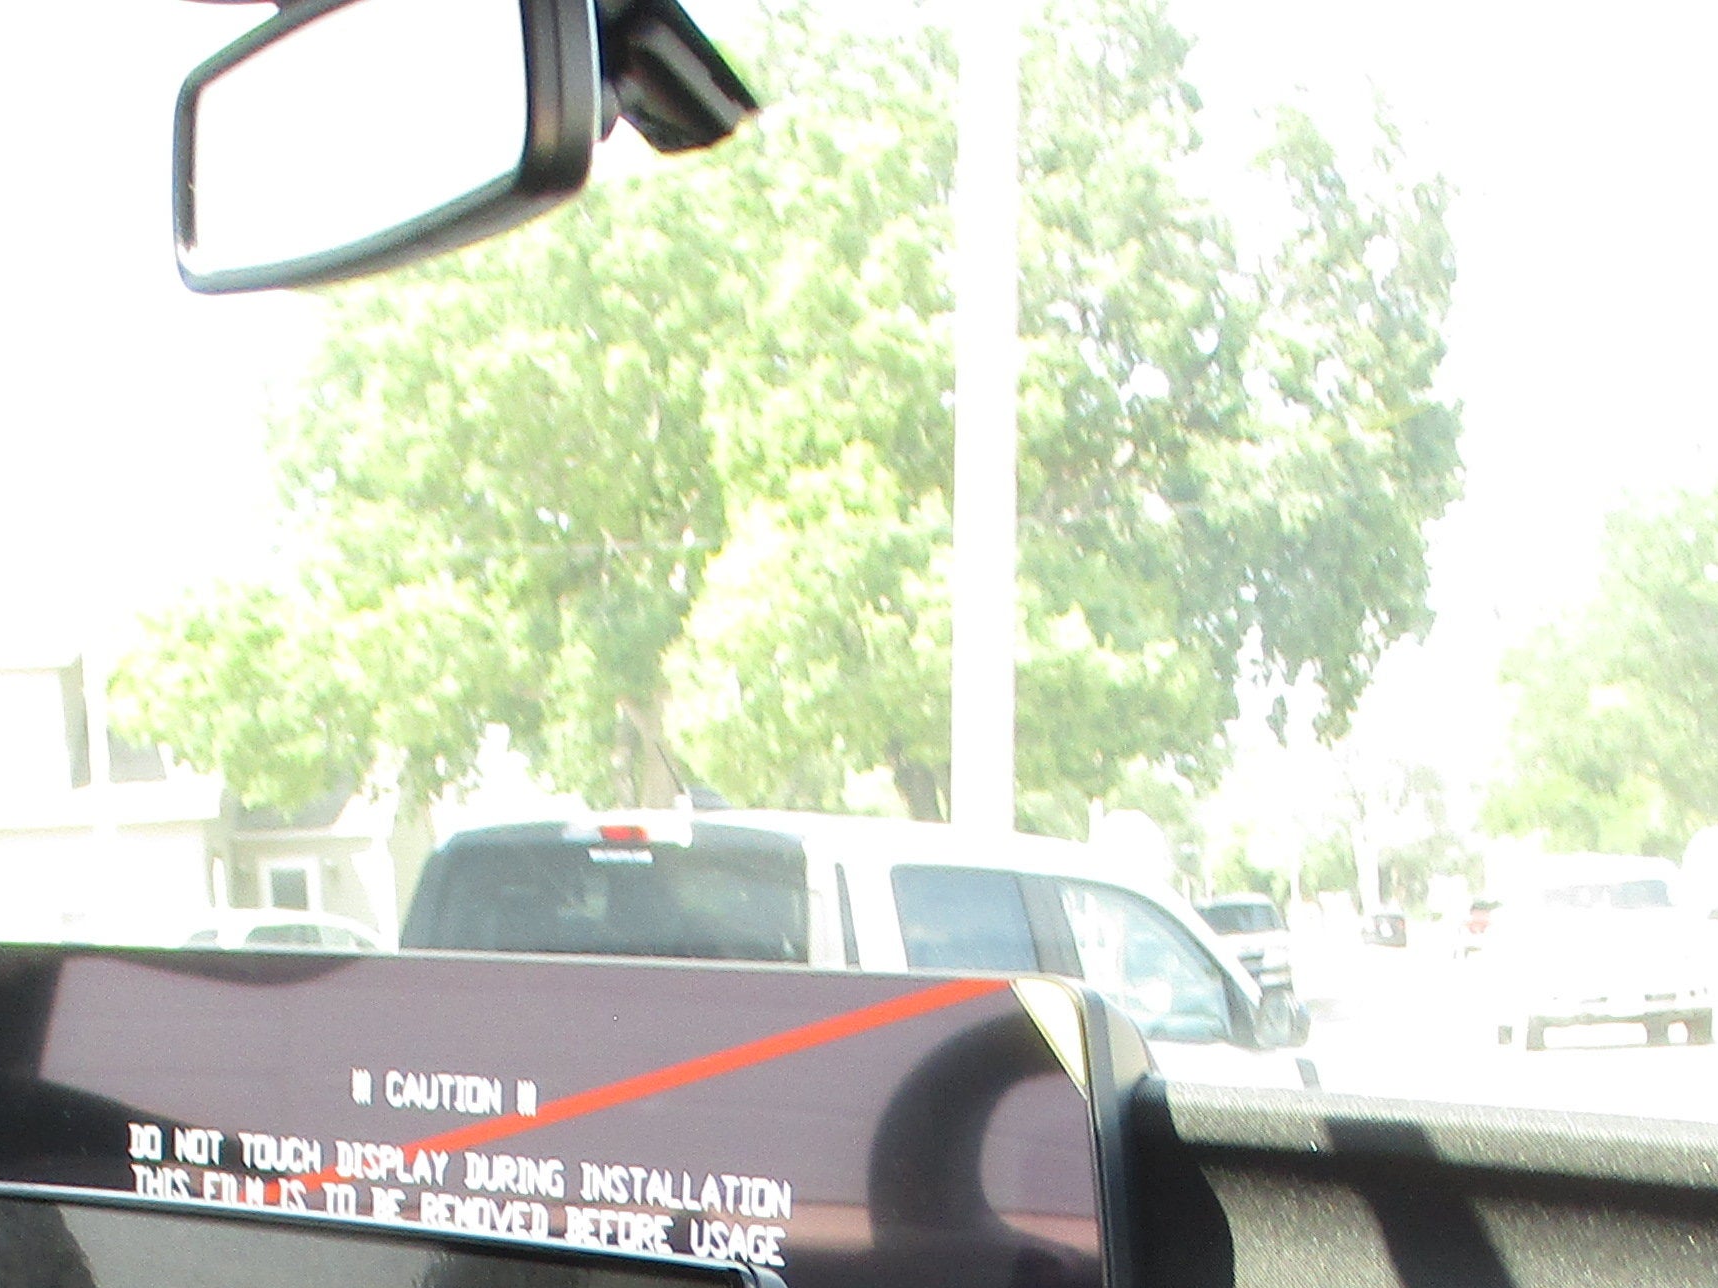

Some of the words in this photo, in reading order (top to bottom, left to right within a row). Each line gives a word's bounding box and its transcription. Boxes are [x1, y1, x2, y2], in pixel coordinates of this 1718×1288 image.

[385, 1070, 502, 1115] CAUTION
[127, 1121, 162, 1162] DO
[175, 1127, 224, 1166] NOT
[238, 1132, 321, 1174] TOUCH
[335, 1140, 449, 1187] DISPLAY
[465, 1151, 564, 1199] DURING
[580, 1161, 792, 1220] INSTALLATION
[131, 1163, 190, 1201] THIS
[280, 1178, 307, 1212] IS
[322, 1182, 358, 1219] TO
[370, 1186, 406, 1224] BE
[421, 1191, 549, 1241] REMOVED
[564, 1205, 674, 1255] BEFORE
[690, 1218, 786, 1267] USAGE
